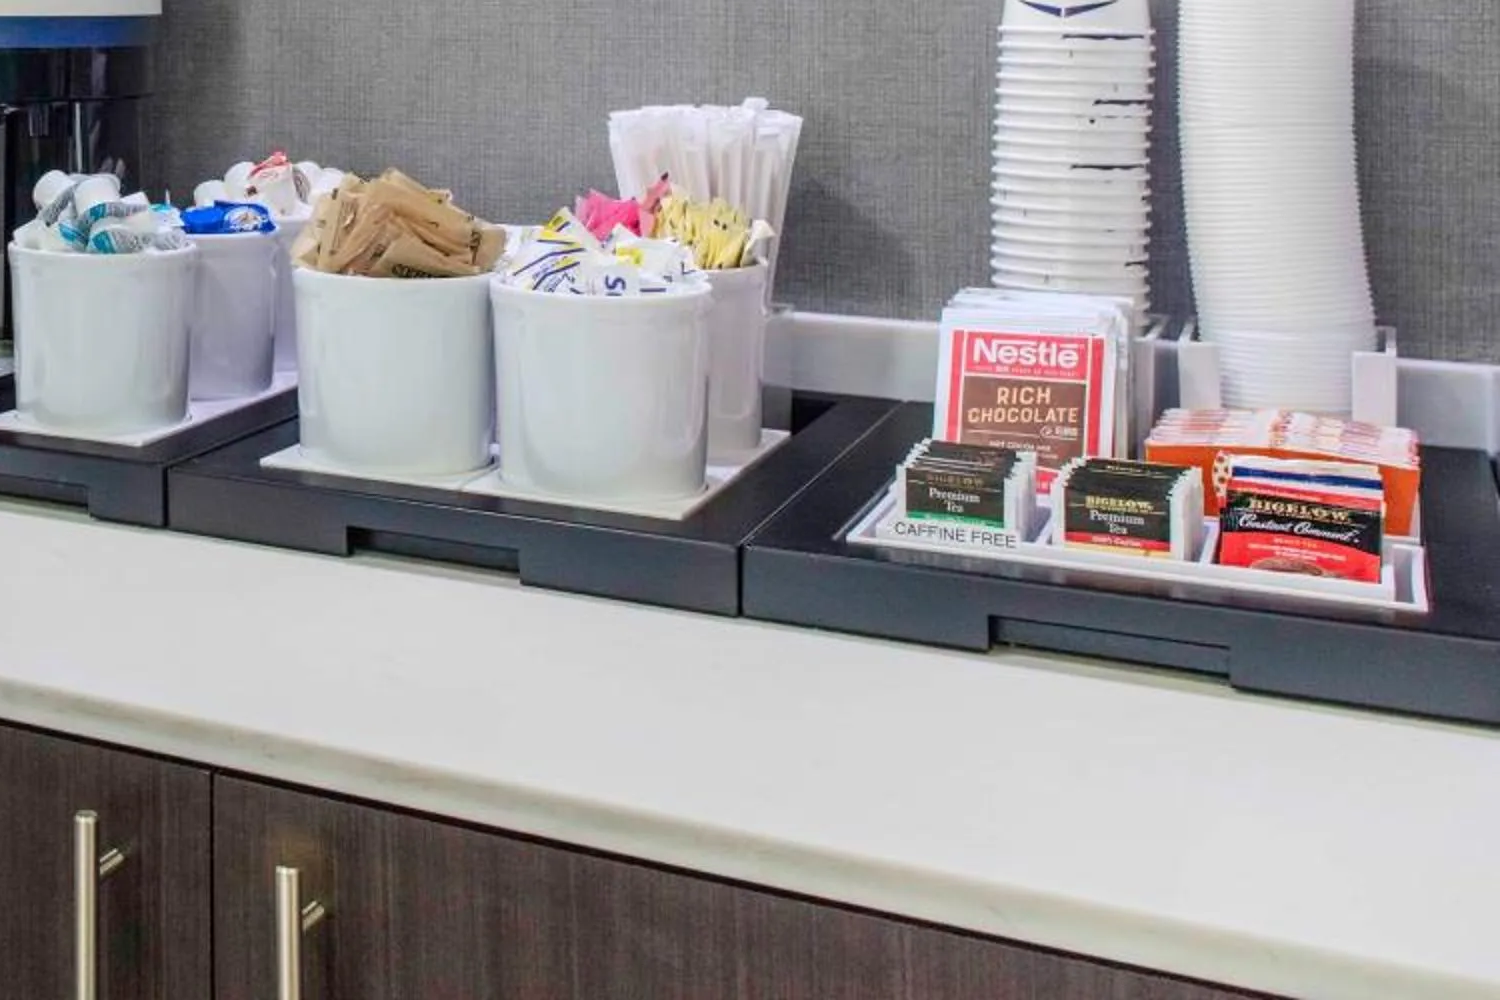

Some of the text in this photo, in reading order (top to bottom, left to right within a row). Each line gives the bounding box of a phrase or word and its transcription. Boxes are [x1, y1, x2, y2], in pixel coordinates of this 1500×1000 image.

[996, 385, 1051, 405] RICH
[967, 406, 1079, 423] CHOCOLATE
[928, 487, 981, 504] Premium
[945, 501, 965, 513] Tea
[1248, 497, 1350, 521] BIGELOW
[1089, 508, 1145, 526] Premium
[895, 521, 1017, 549] CAFFINE FREE
[1105, 521, 1129, 535] Tea
